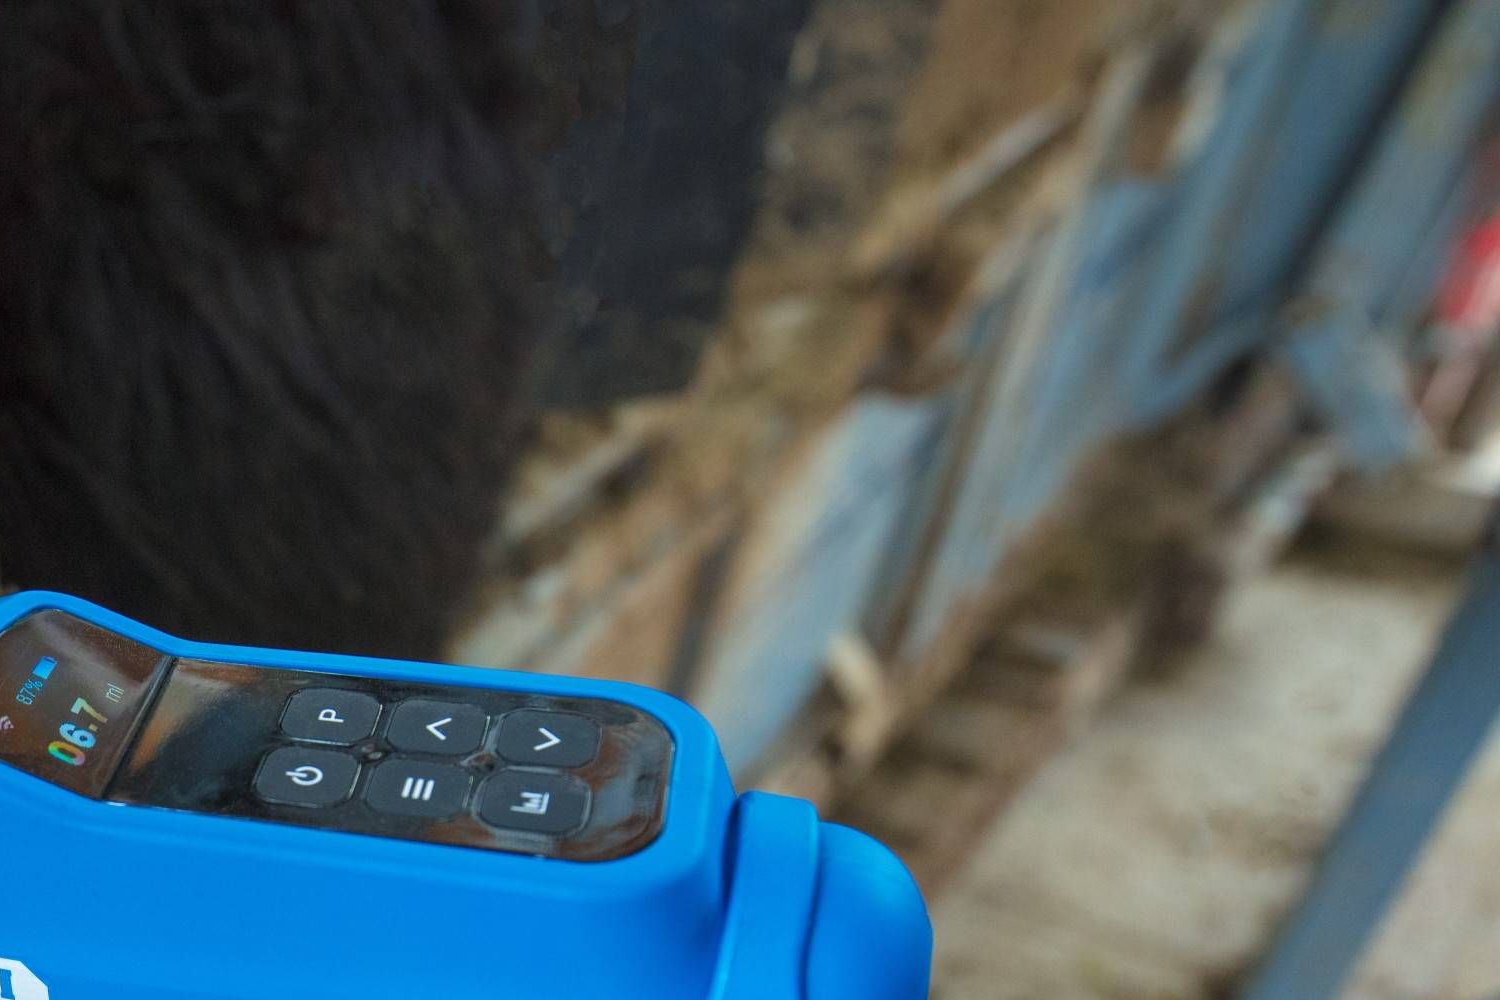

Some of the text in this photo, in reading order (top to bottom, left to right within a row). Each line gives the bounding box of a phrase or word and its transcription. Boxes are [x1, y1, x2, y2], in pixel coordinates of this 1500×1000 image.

[15, 679, 44, 705] 87%
[48, 683, 125, 766] 06.7 ml
[318, 708, 345, 723] P
